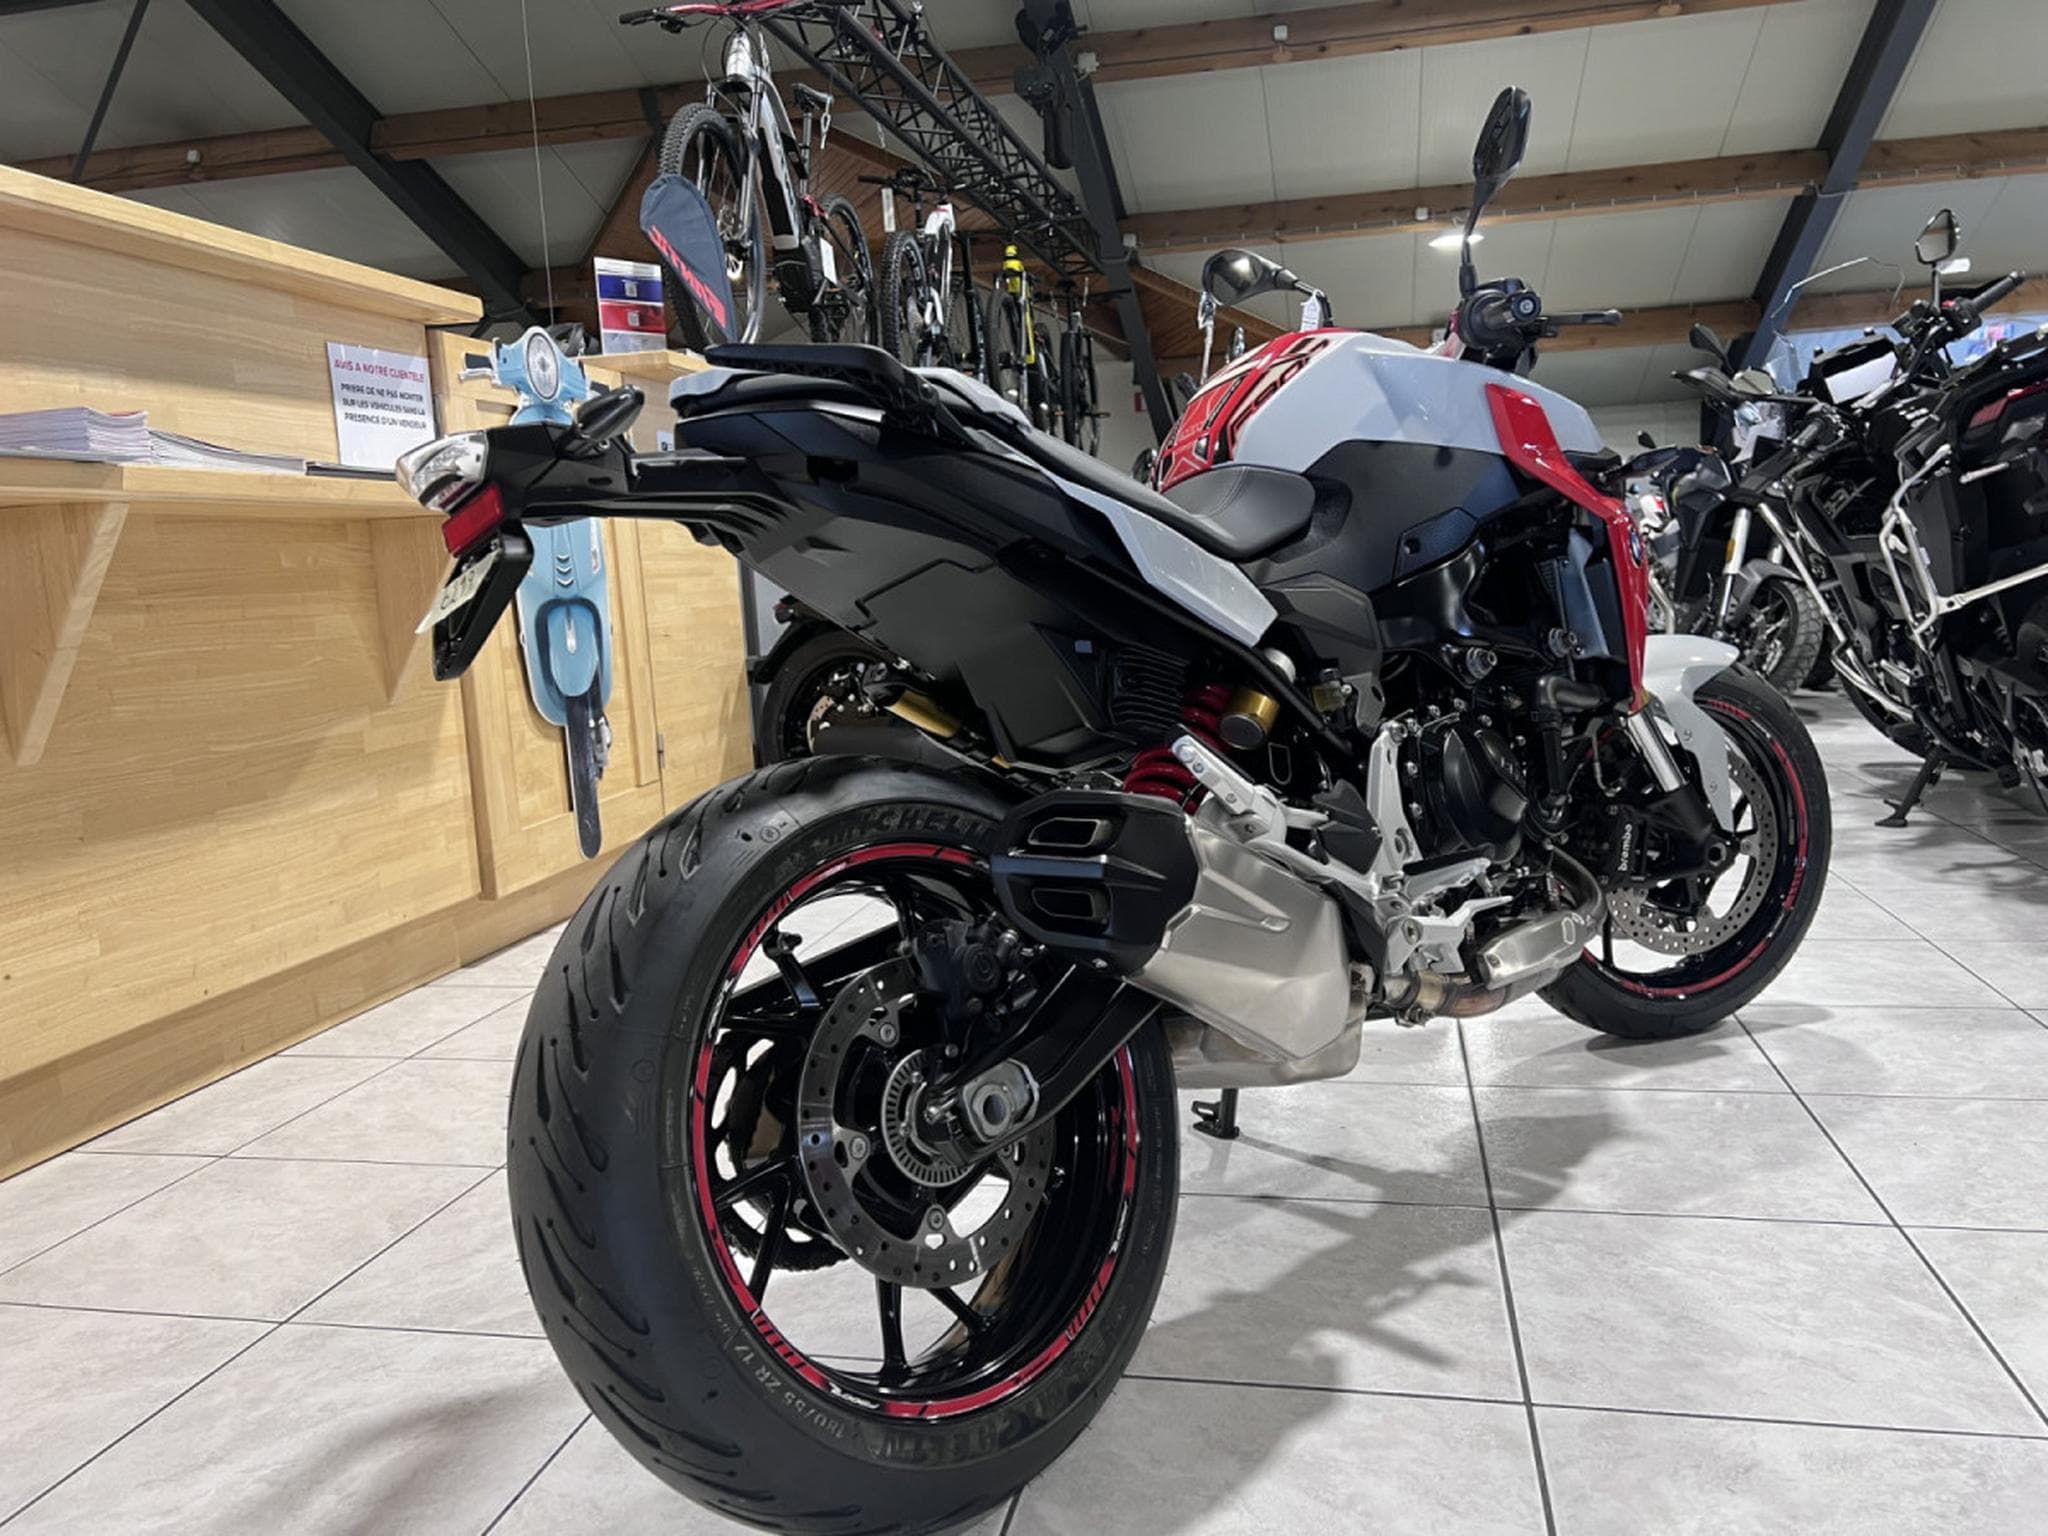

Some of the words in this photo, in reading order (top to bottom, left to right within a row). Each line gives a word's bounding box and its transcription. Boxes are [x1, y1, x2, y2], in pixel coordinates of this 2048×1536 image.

[335, 360, 353, 371] AVIS
[363, 363, 388, 377] NOTRE
[389, 369, 424, 382] CLIENTELE
[341, 383, 364, 393] PRIERE
[366, 386, 374, 395] DE
[376, 388, 384, 396] NE
[386, 389, 398, 399] PAS
[399, 392, 423, 401] MONTER
[343, 398, 355, 406] SUR
[357, 400, 369, 409] LES
[370, 401, 402, 412] VEHICULES
[403, 406, 416, 414] SANS
[345, 412, 379, 423] PRESENCE
[399, 419, 427, 429] VENDEUR
[1617, 823, 1633, 872] brembo
[734, 1344, 754, 1364] 17
[755, 1365, 781, 1393] ZR
[784, 1391, 846, 1438] 180/55
